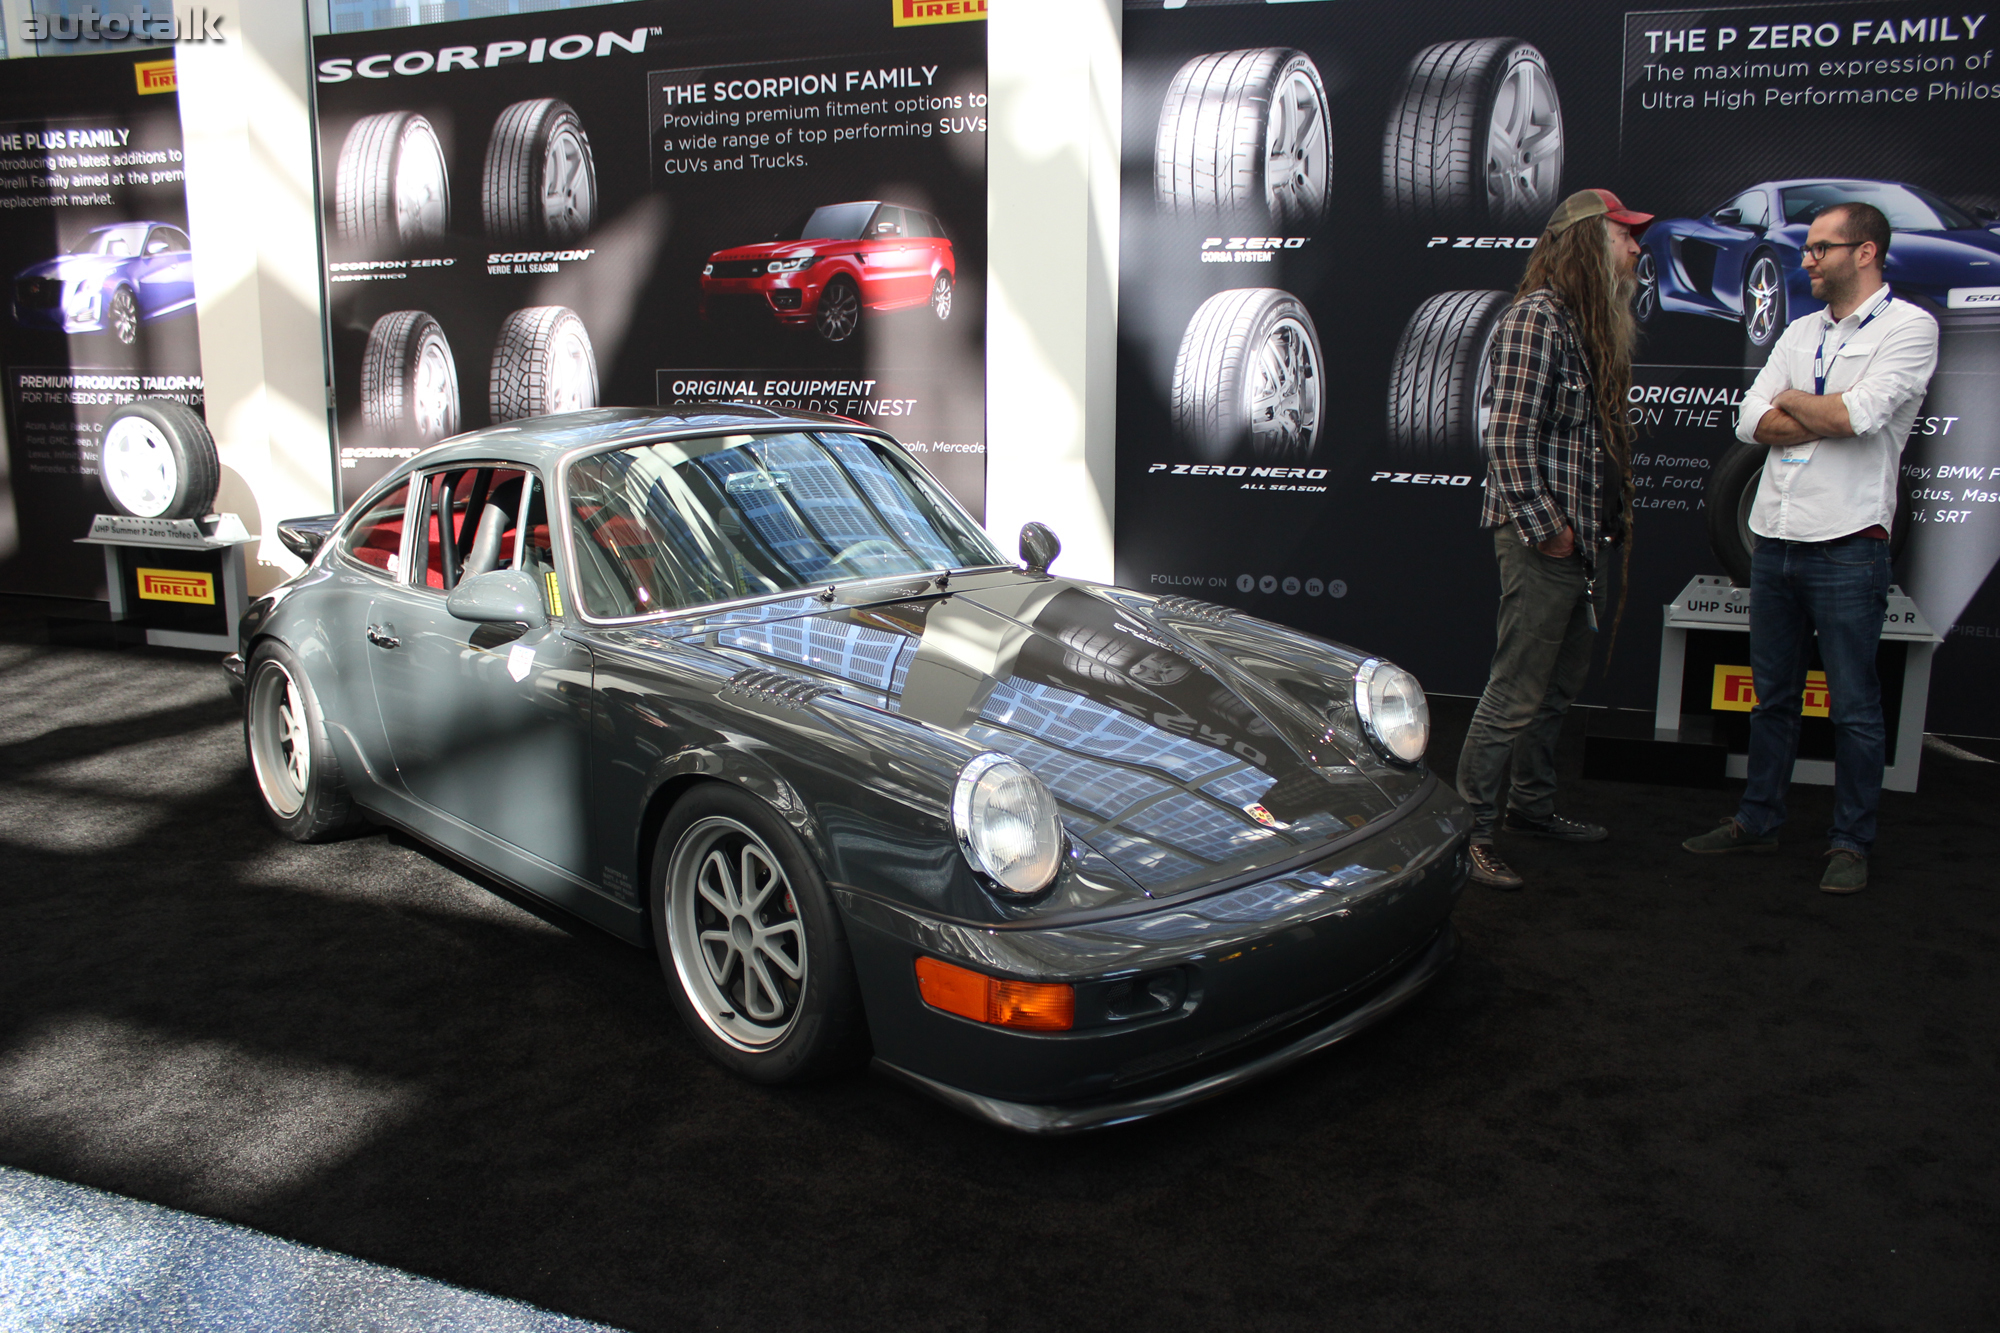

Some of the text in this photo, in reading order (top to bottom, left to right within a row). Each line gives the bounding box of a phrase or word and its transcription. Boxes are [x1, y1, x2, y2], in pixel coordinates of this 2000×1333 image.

[1644, 14, 1986, 53] THE P ZERO FAMILY
[1643, 50, 1993, 81] The maximum expression of
[663, 65, 938, 105] THE SCORPION FAMILY
[1641, 91, 1694, 109] Ultra
[1704, 89, 1755, 110] High
[1764, 86, 1918, 107] Performance
[664, 92, 987, 128] Providing premium fitment options to
[25, 131, 66, 149] PLUS
[67, 128, 130, 149] FAMILY
[664, 116, 987, 151] a wide range of top performing SUVs
[58, 154, 78, 169] the
[79, 154, 111, 168] latest
[113, 151, 166, 167] additions
[168, 149, 183, 162] to
[665, 151, 808, 174] CUVs and Trucks.
[31, 173, 69, 190] Family
[73, 173, 109, 187] aimed
[112, 174, 125, 186] at
[128, 171, 149, 185] the
[71, 192, 115, 206] market.
[1201, 237, 1306, 249] P ZERO
[1426, 236, 1539, 249] P ZERO
[1201, 251, 1233, 262] CORSA
[487, 262, 559, 275] VERDE ALL SEASON
[20, 375, 72, 389] PREMIUM
[73, 375, 140, 391] PRODUCTS
[672, 380, 876, 396] ORIGINAL EQUIPMENT
[22, 393, 42, 404] FOR
[44, 392, 63, 404] THE
[64, 393, 96, 405] NEEDS
[99, 393, 113, 405] OF
[114, 393, 134, 405] THE
[1627, 386, 1741, 406] ORIGINAL
[845, 400, 917, 417] FINEST
[1626, 408, 1664, 425] ON
[1674, 409, 1722, 428] THE
[1630, 453, 1711, 470] lfa Romeo,
[1148, 464, 1329, 479] P ZERO NERO
[1936, 465, 1985, 481] BMW,
[1269, 484, 1328, 492] SEASON
[1631, 474, 1704, 491] iat, Ford,
[1911, 487, 1954, 503] otus,
[1632, 496, 1690, 511] cLaren,
[1934, 510, 1972, 524] SRT
[95, 525, 199, 540] UHP Summer P Zero Trofeo R
[143, 574, 208, 598] PIRELLI
[1151, 574, 1227, 587] FOLLOW ON
[1687, 600, 1719, 613] UHP
[1904, 612, 1915, 624] R
